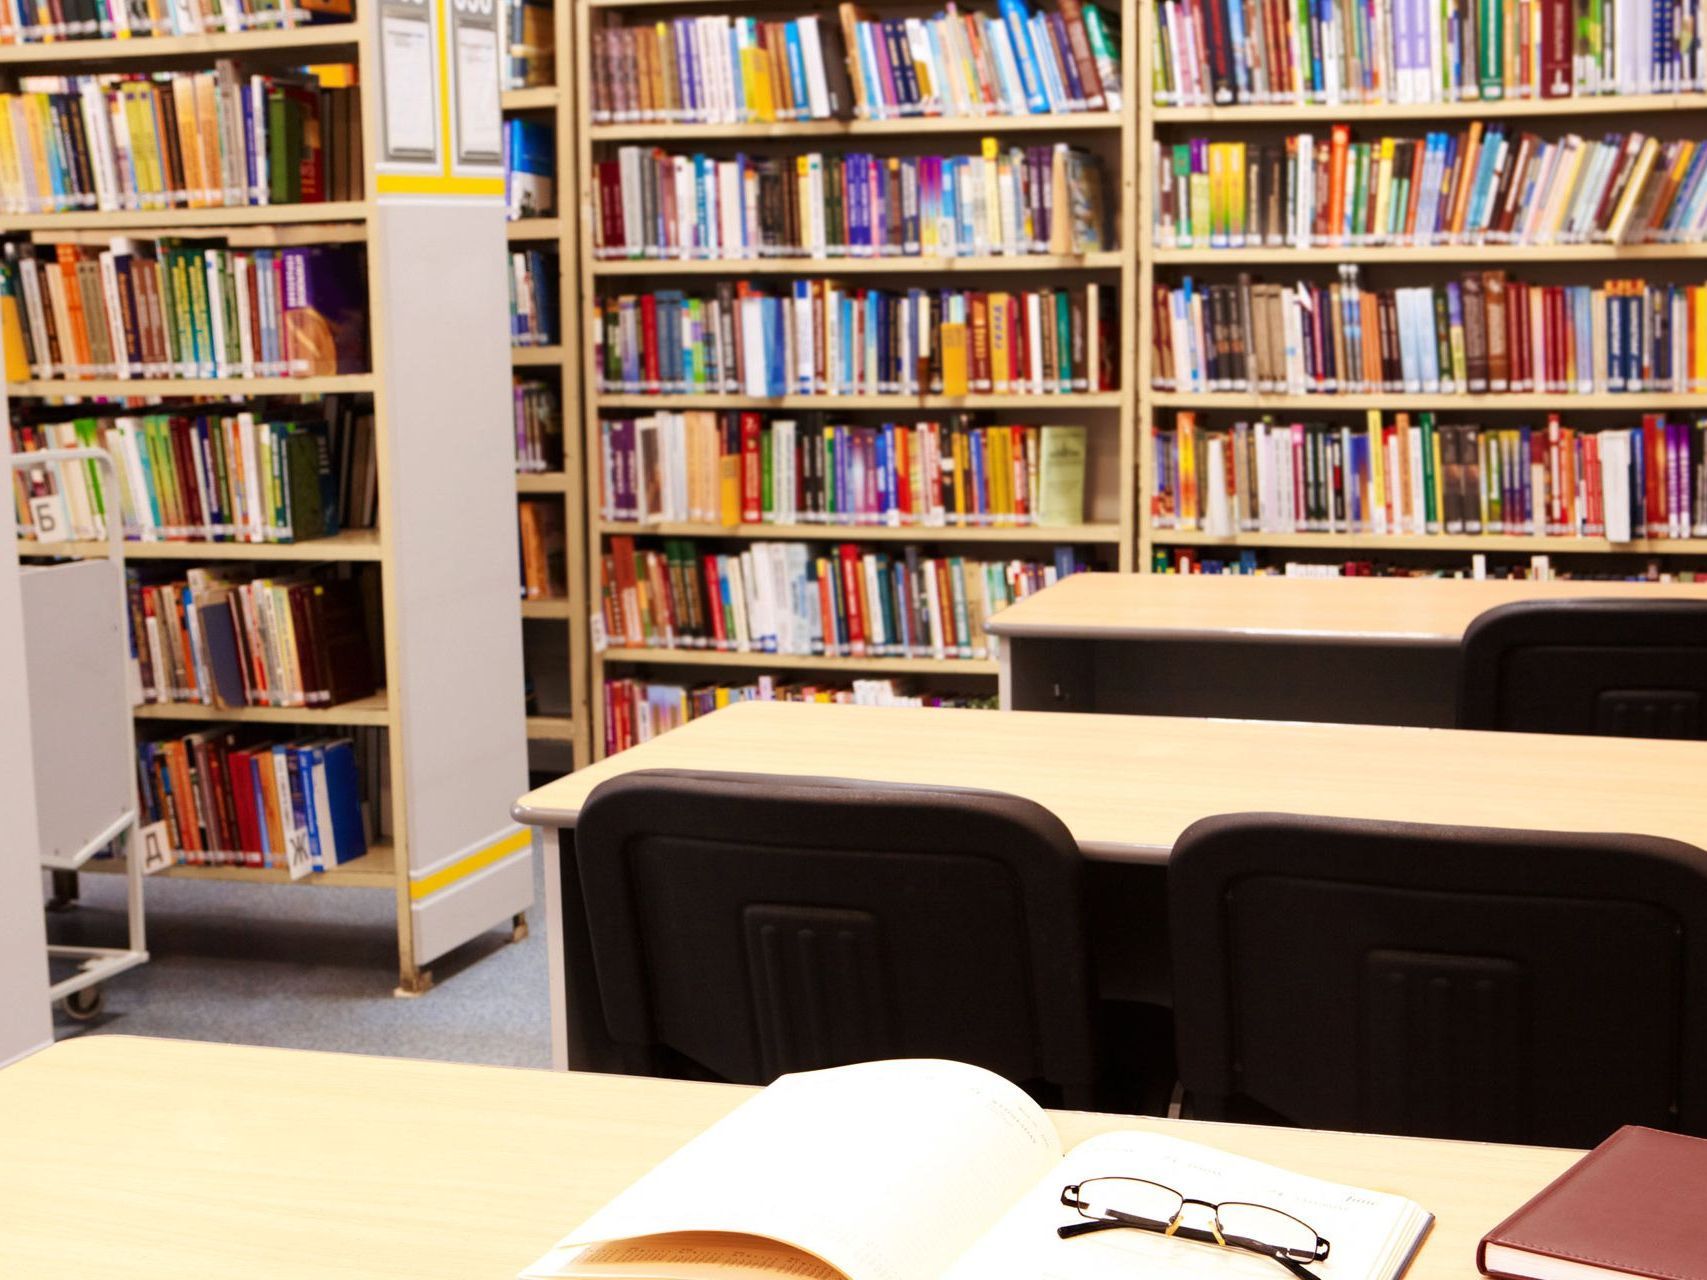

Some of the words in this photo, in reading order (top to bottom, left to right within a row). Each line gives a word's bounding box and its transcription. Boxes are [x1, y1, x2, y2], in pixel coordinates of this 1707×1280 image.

[36, 503, 56, 532] Б
[145, 832, 164, 868] Д
[290, 832, 309, 866] Ж
